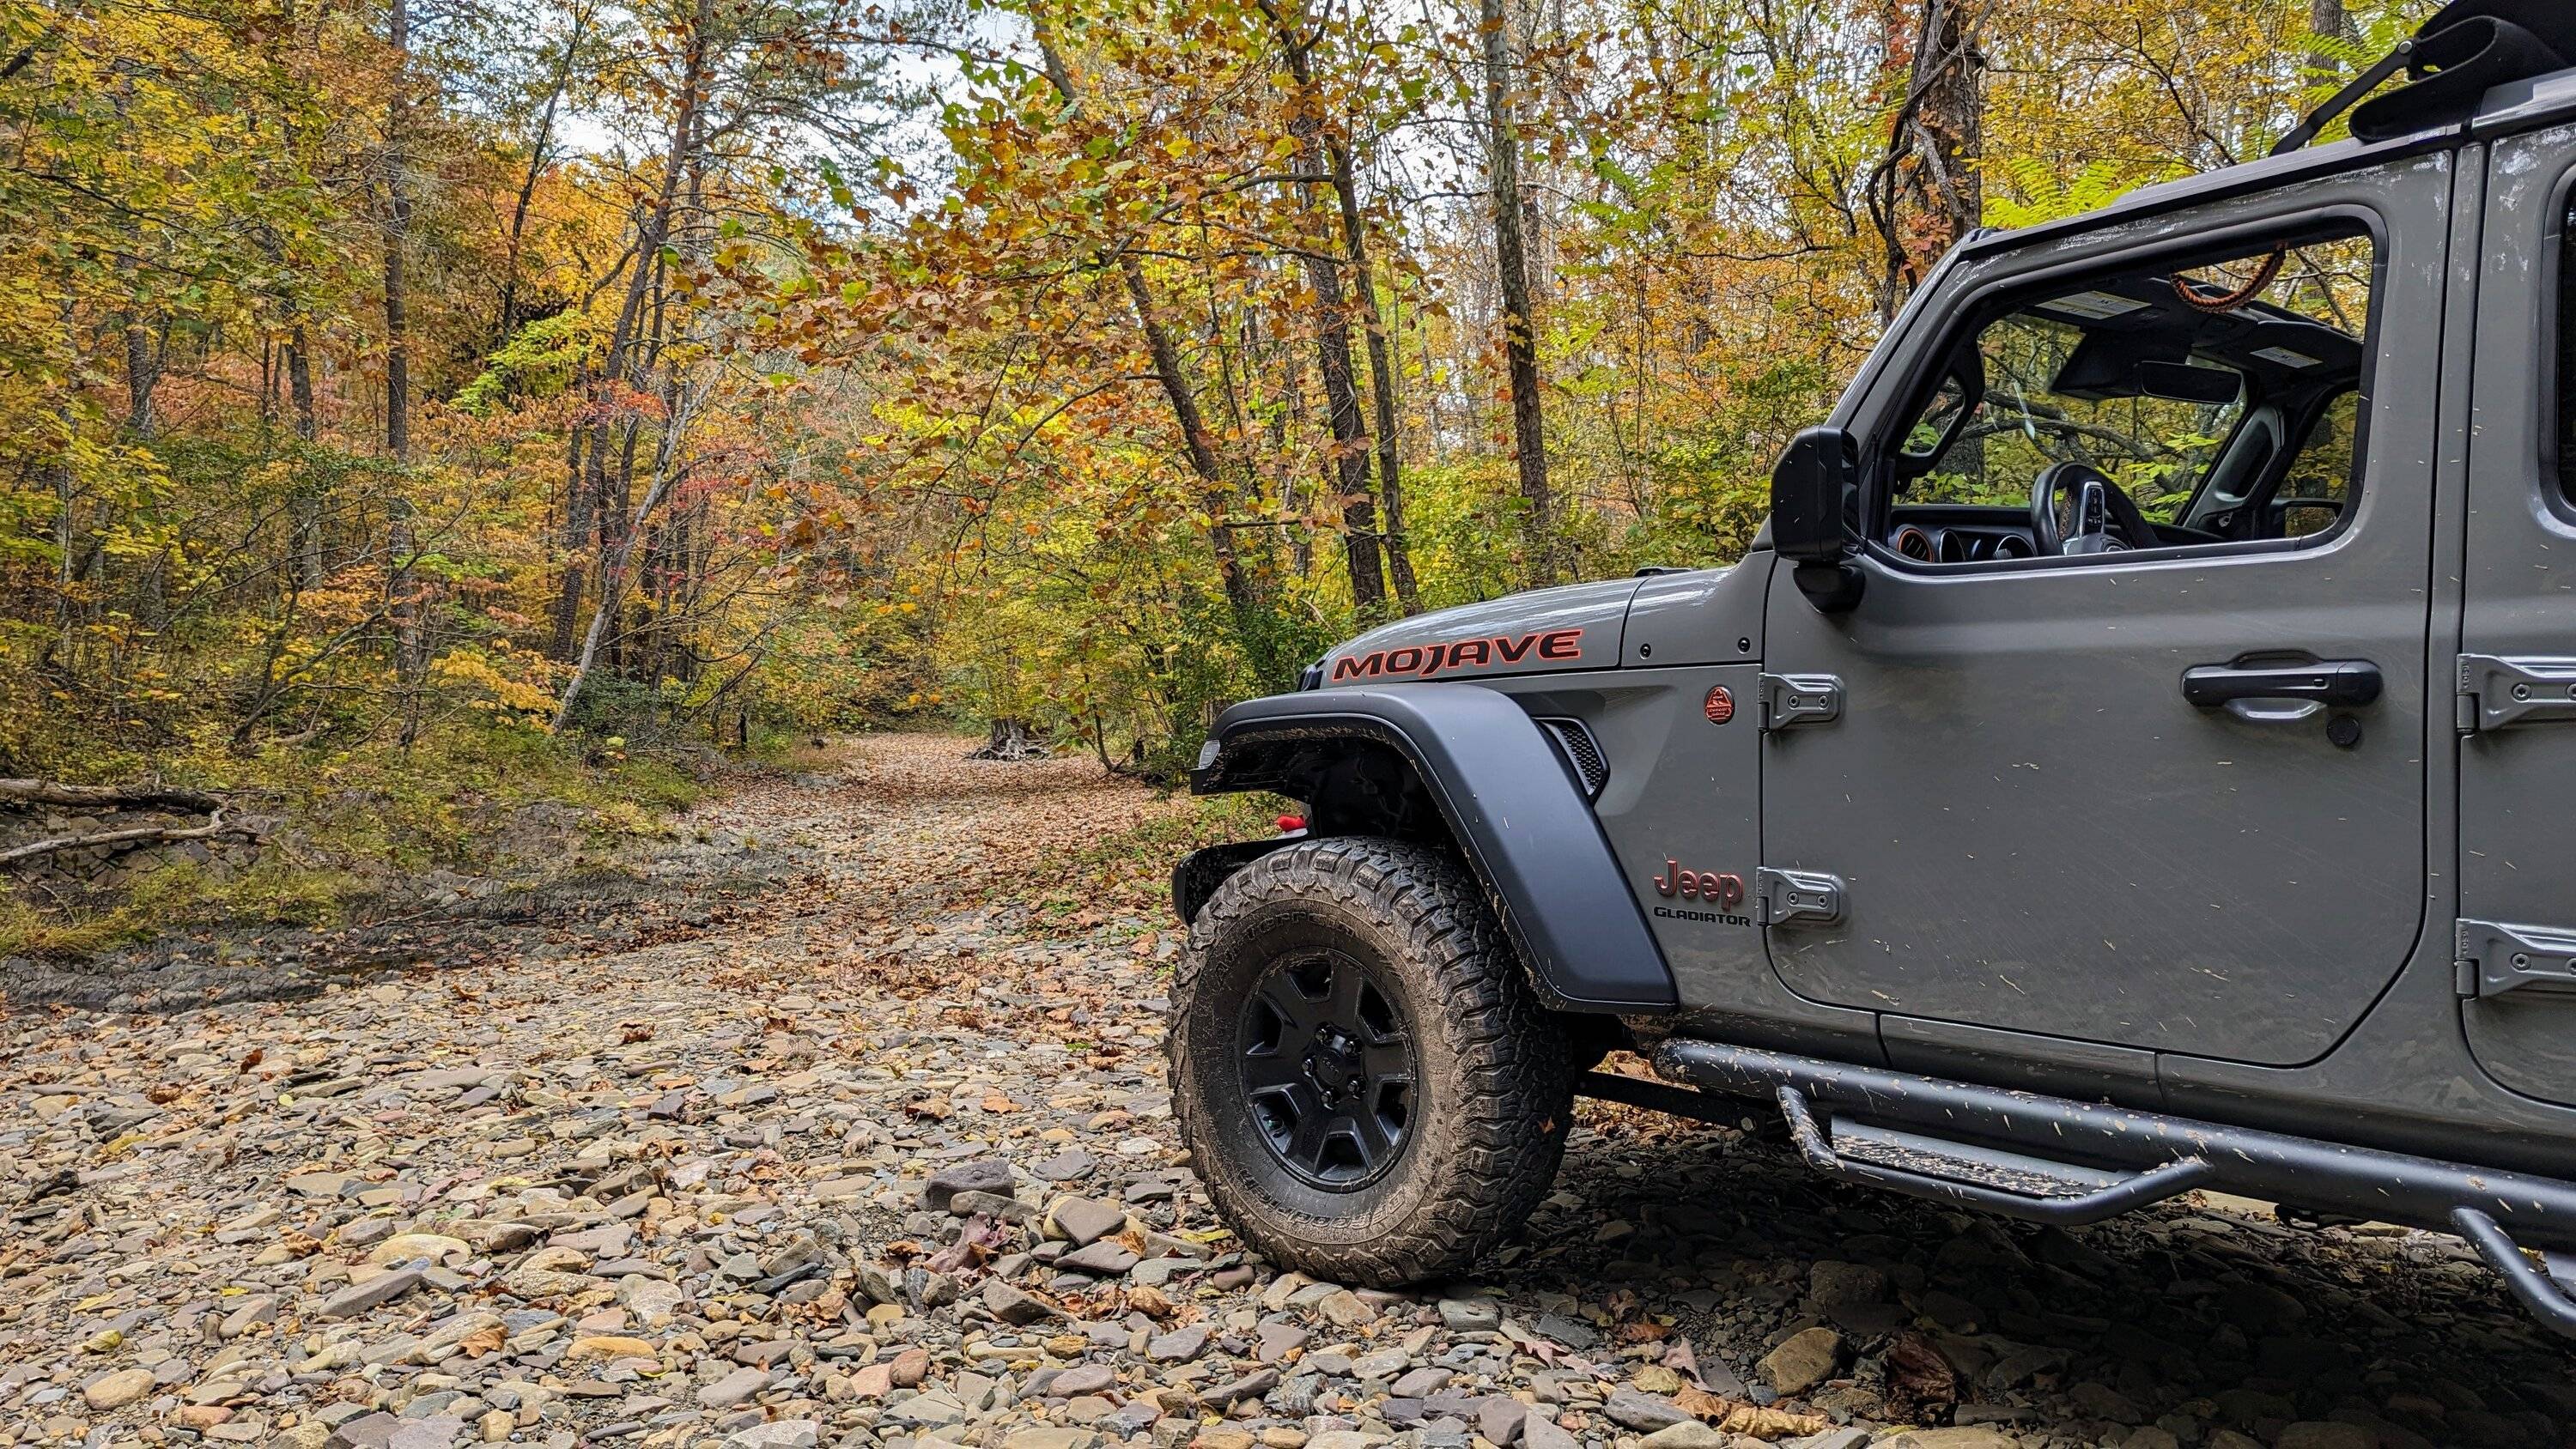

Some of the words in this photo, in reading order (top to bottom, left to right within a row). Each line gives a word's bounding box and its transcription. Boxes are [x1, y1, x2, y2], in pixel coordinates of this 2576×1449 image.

[1332, 628, 1584, 682] MOJAVE
[1653, 860, 1744, 912] Jeep
[1653, 906, 1751, 928] GLADIATOR
